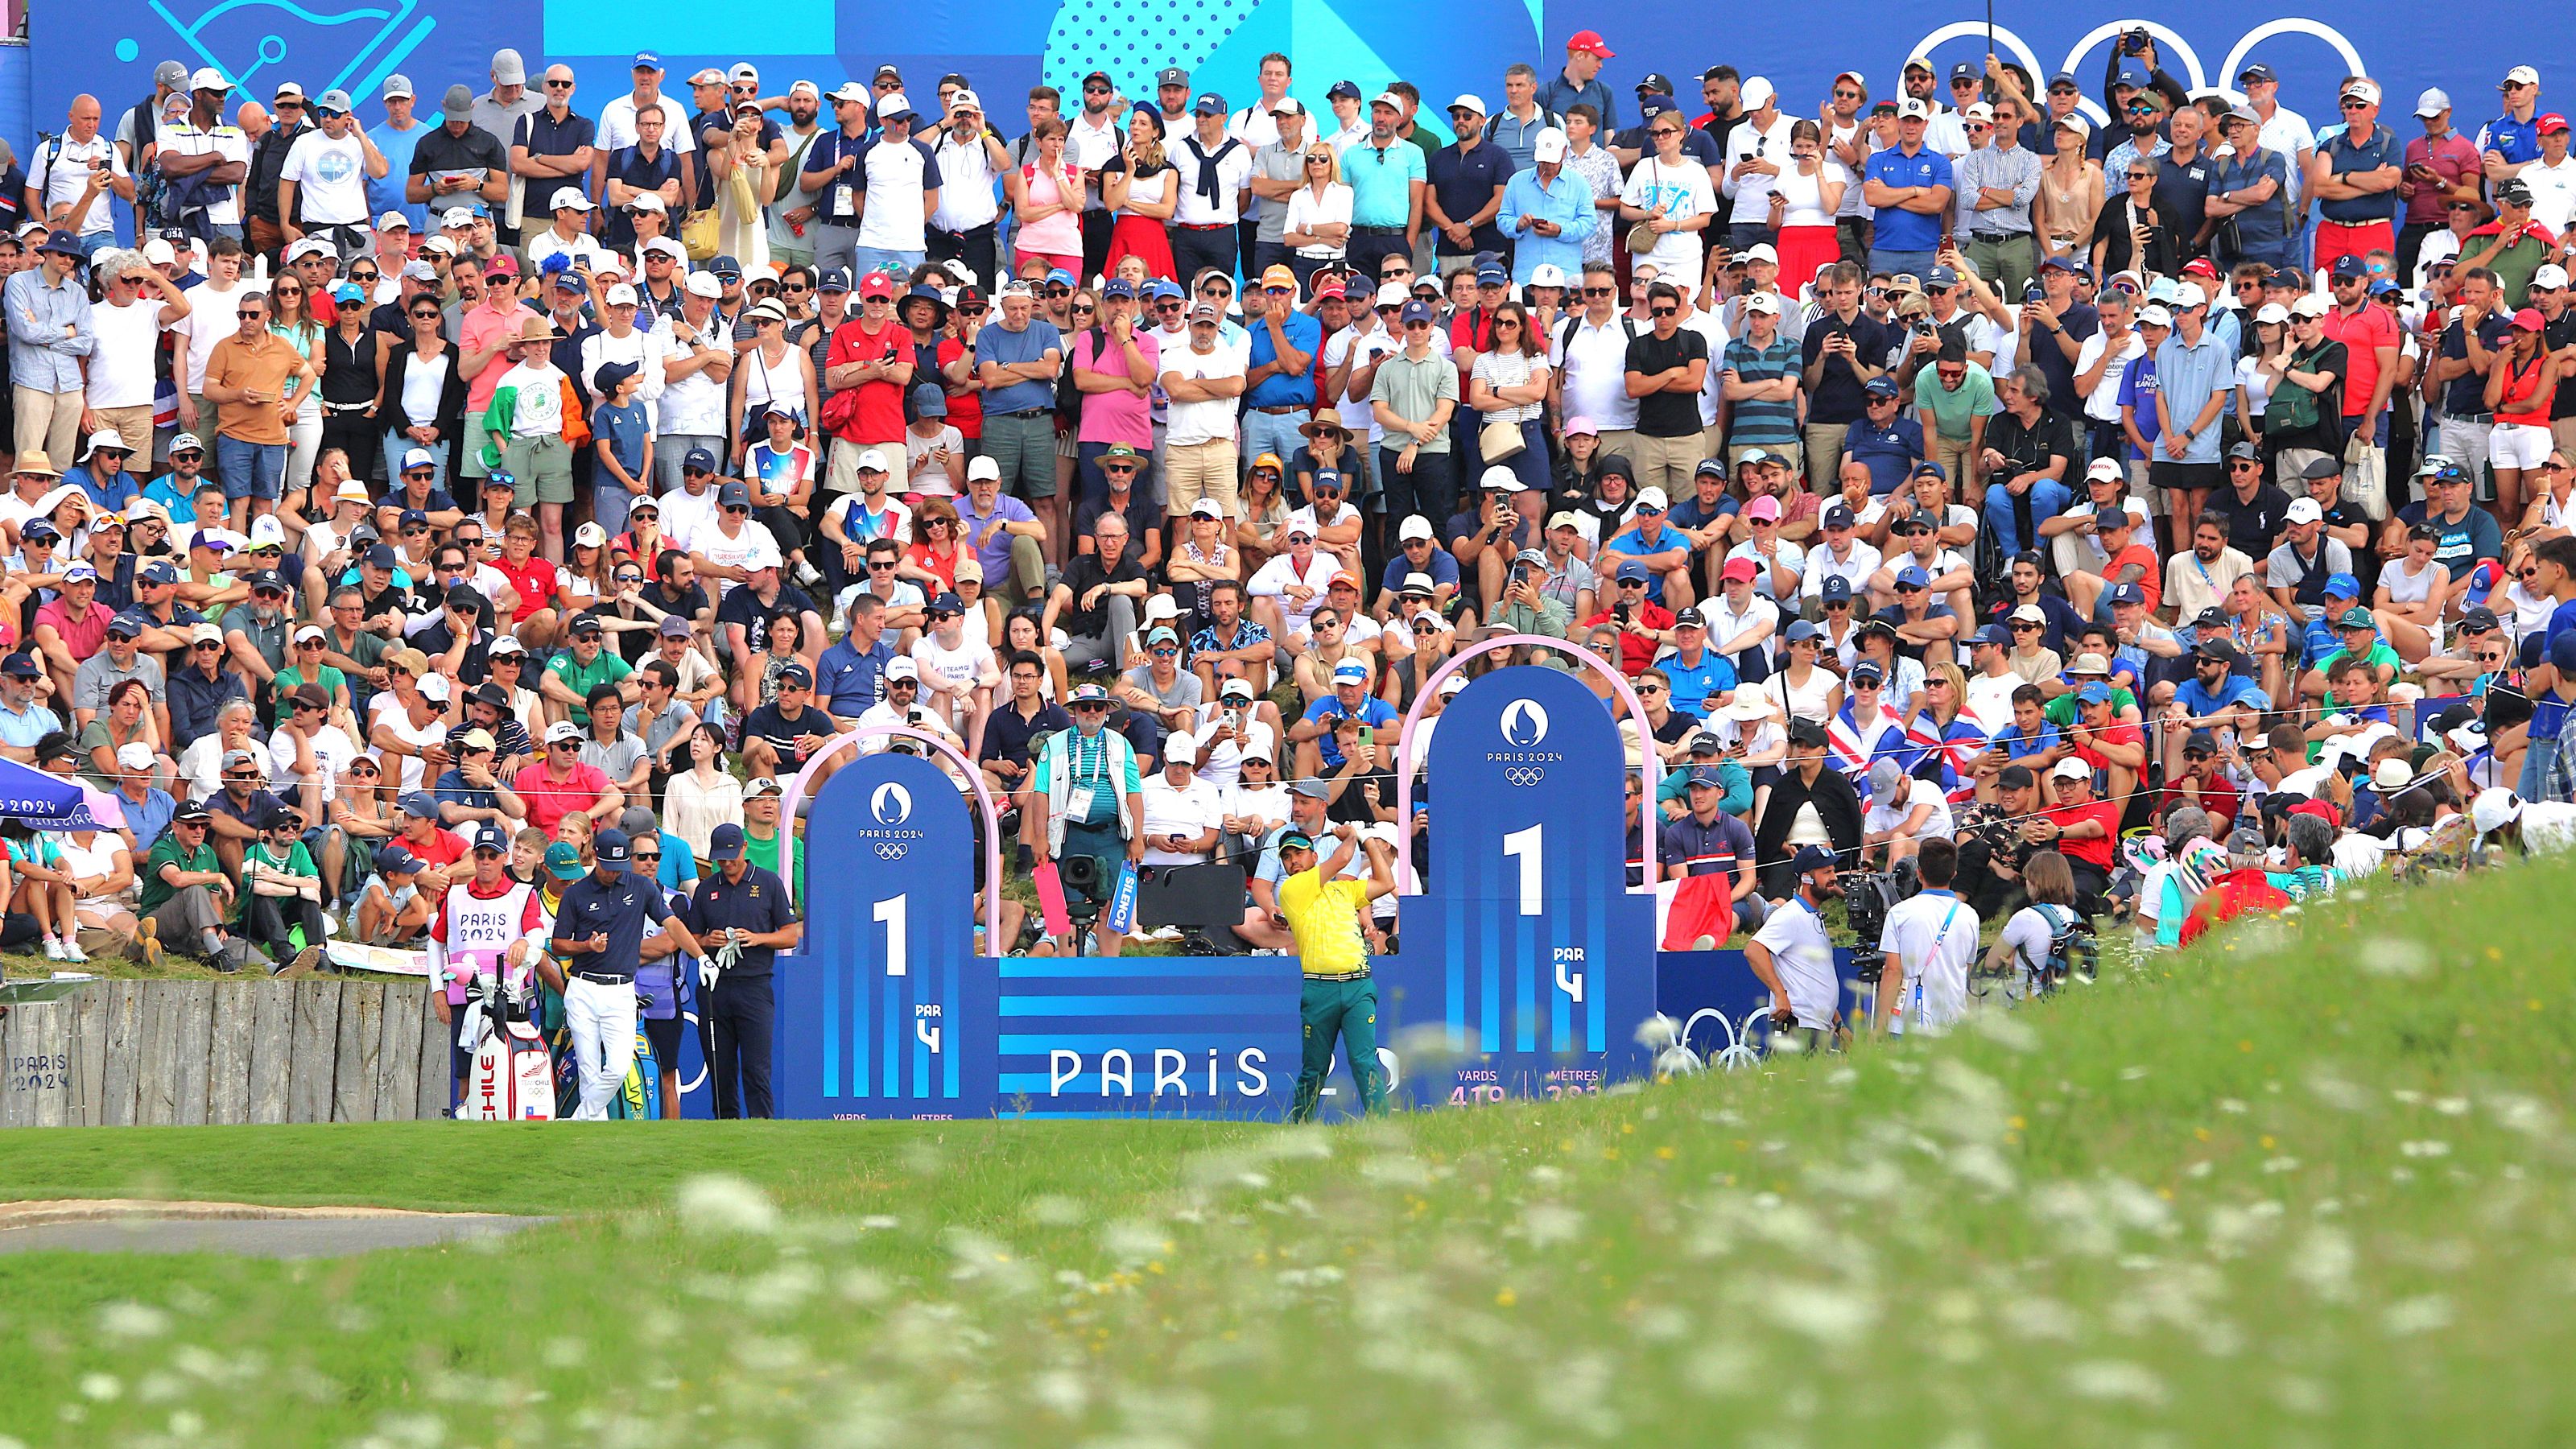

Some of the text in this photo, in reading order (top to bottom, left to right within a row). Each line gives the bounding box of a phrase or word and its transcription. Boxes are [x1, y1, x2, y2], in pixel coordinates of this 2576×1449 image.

[879, 64, 897, 73] FRANCE
[1645, 179, 1694, 188] SUN BLISS
[166, 230, 184, 240] USA
[559, 272, 579, 286] 1895
[1319, 473, 1337, 482] FRANCE
[553, 658, 567, 670] 3
[947, 672, 966, 680] PARIS
[1487, 753, 1563, 762] PARIS 2024
[9, 799, 56, 814] 2024
[859, 829, 924, 839] PARIS 2024
[1502, 822, 1543, 917] 1
[1113, 876, 1136, 930] SILENCE
[460, 912, 507, 927] PARIS
[460, 928, 506, 942] 2024
[872, 892, 907, 976] 1
[1553, 947, 1585, 962] PAR
[1554, 964, 1583, 1003] 4
[914, 1004, 943, 1018] PAR
[916, 1018, 940, 1054] 4
[14, 1054, 67, 1072] PARIS
[1049, 1047, 1269, 1098] PARIS
[1456, 1070, 1498, 1083] YARDS
[14, 1073, 69, 1092] 2024
